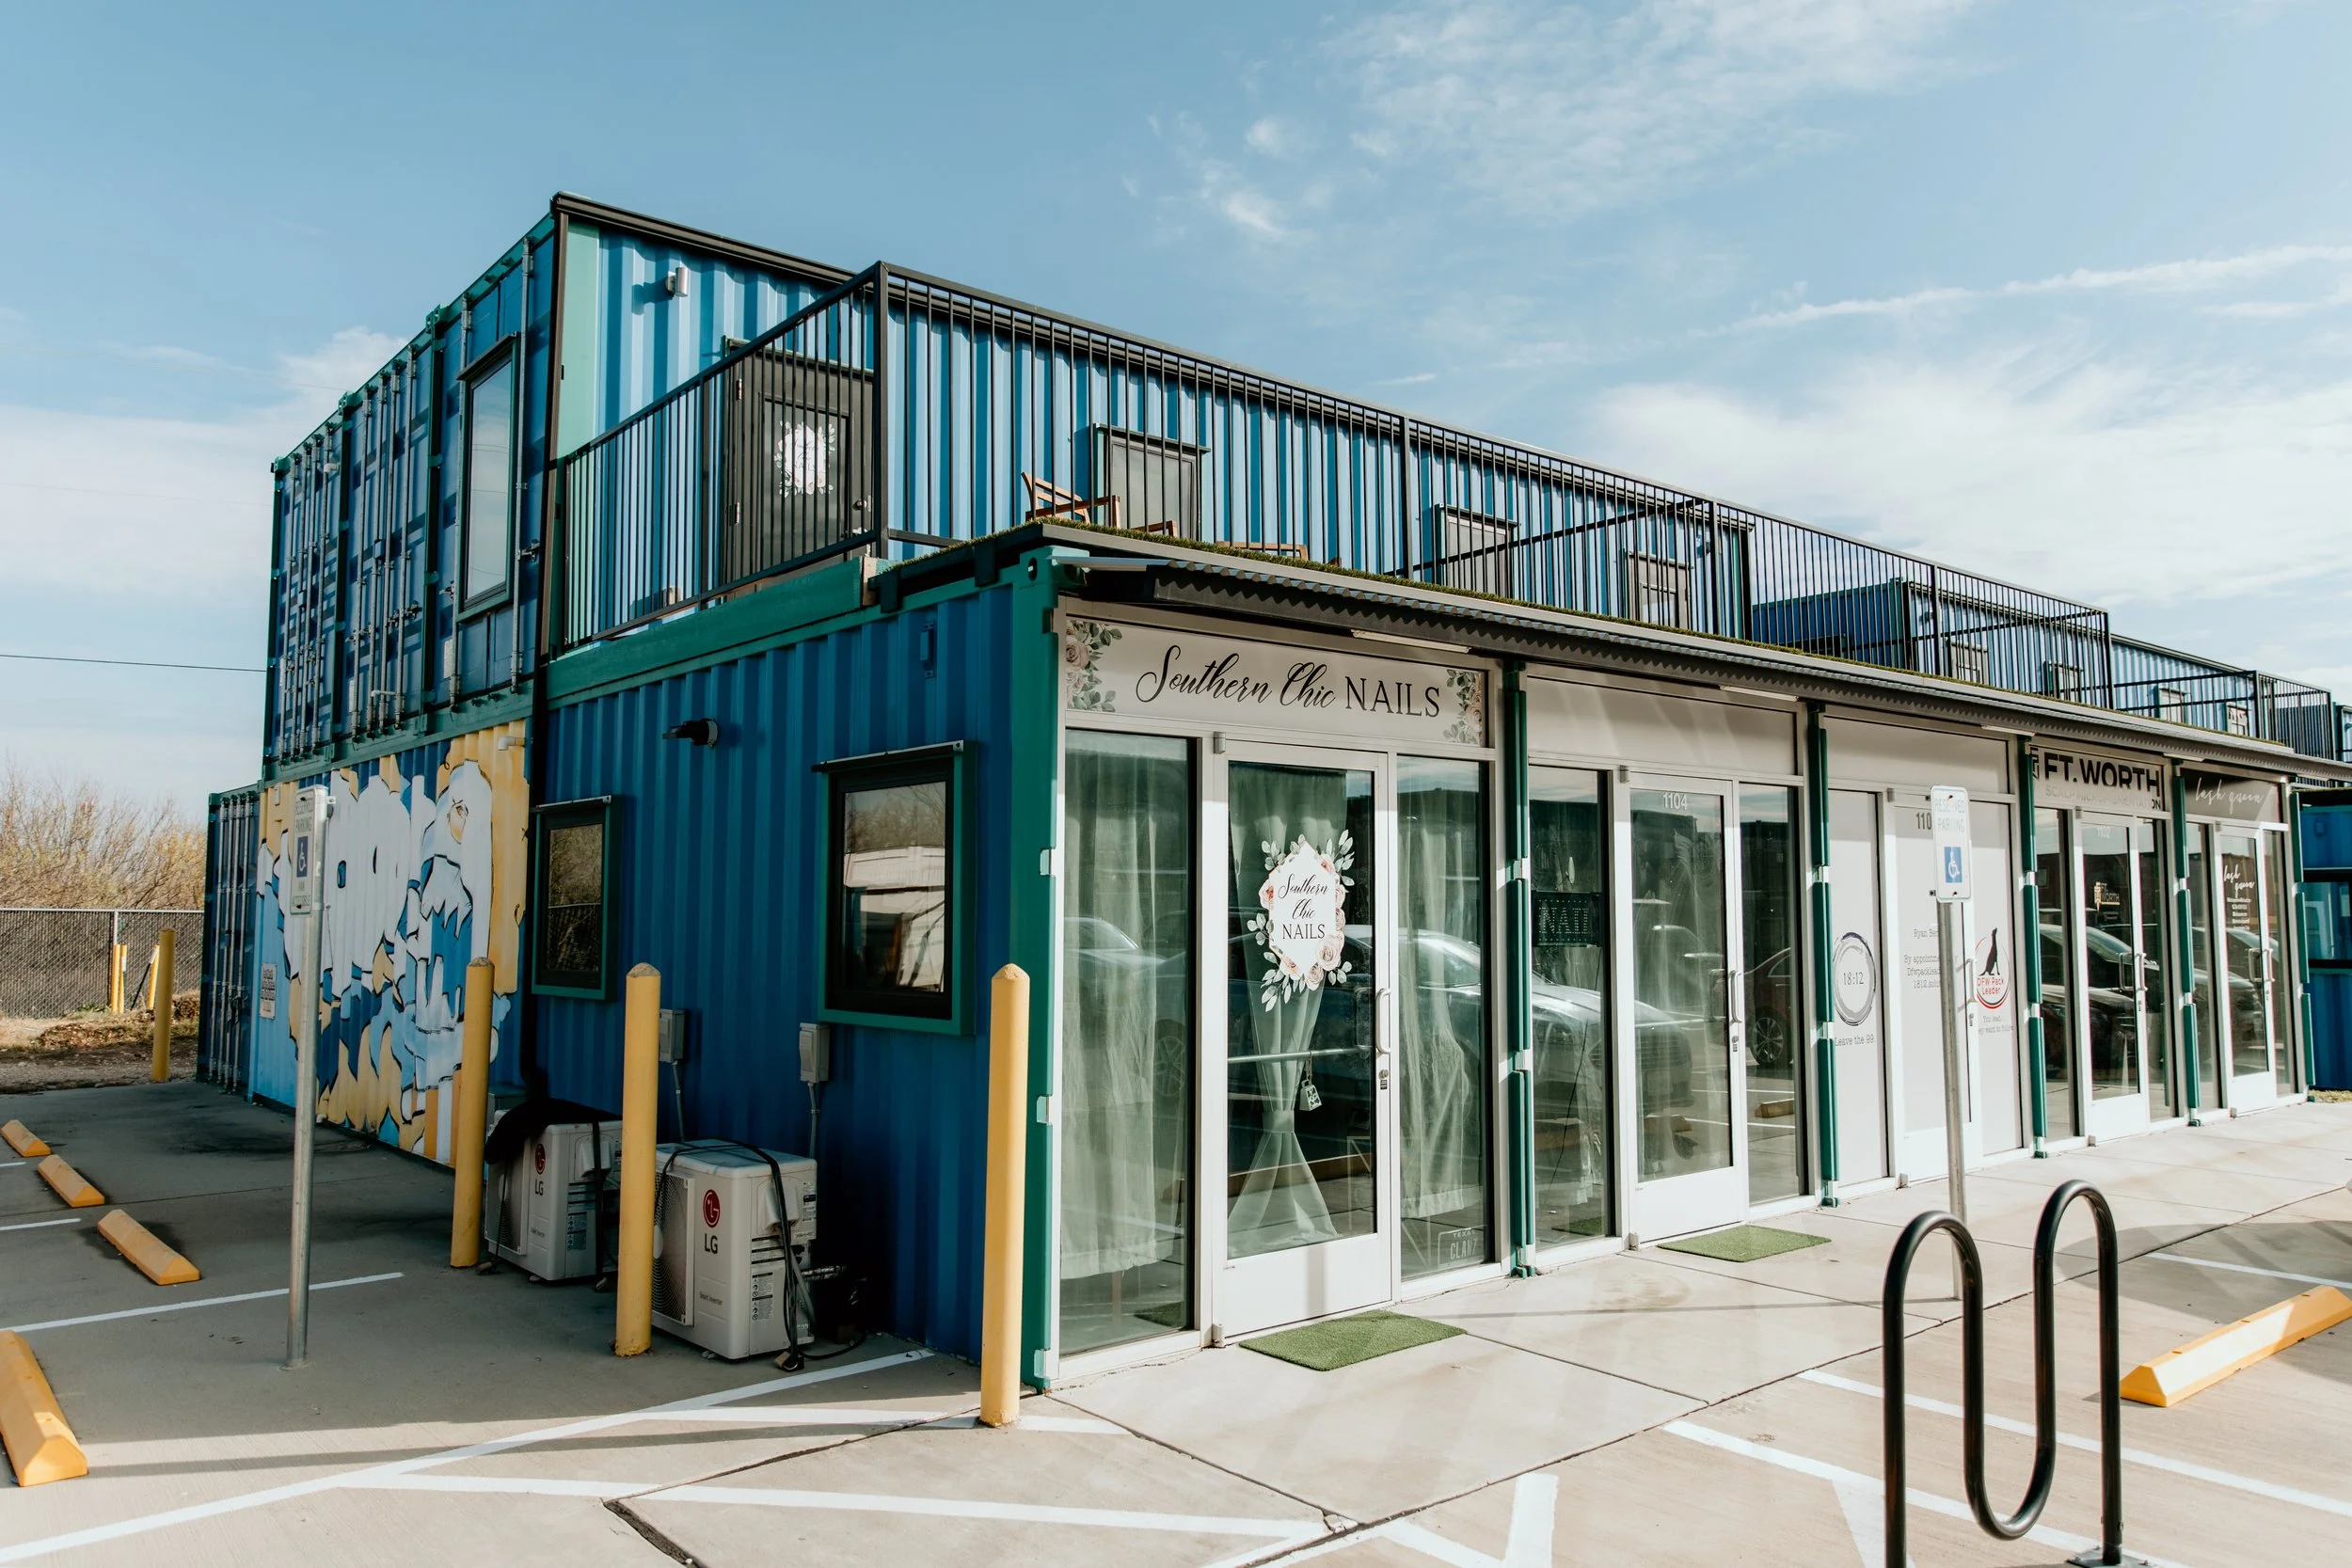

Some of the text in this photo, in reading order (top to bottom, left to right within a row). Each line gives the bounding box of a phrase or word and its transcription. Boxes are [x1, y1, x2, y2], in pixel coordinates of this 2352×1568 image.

[1136, 644, 1440, 719] Southern Chic NAILS
[2195, 777, 2226, 805] lash
[1662, 792, 1688, 810] 1104
[1915, 812, 1932, 830] 110
[1278, 874, 1328, 899] Southern
[1292, 898, 1316, 920] Chic
[1282, 923, 1326, 940] NAILS
[1843, 971, 1865, 986] 18:12
[1978, 976, 2005, 987] DFW Pack
[1834, 1037, 1852, 1047] Leave
[1853, 1035, 1865, 1045] the
[534, 1178, 545, 1196] LG
[1453, 1229, 1476, 1239] TEXAS
[704, 1232, 719, 1255] LG
